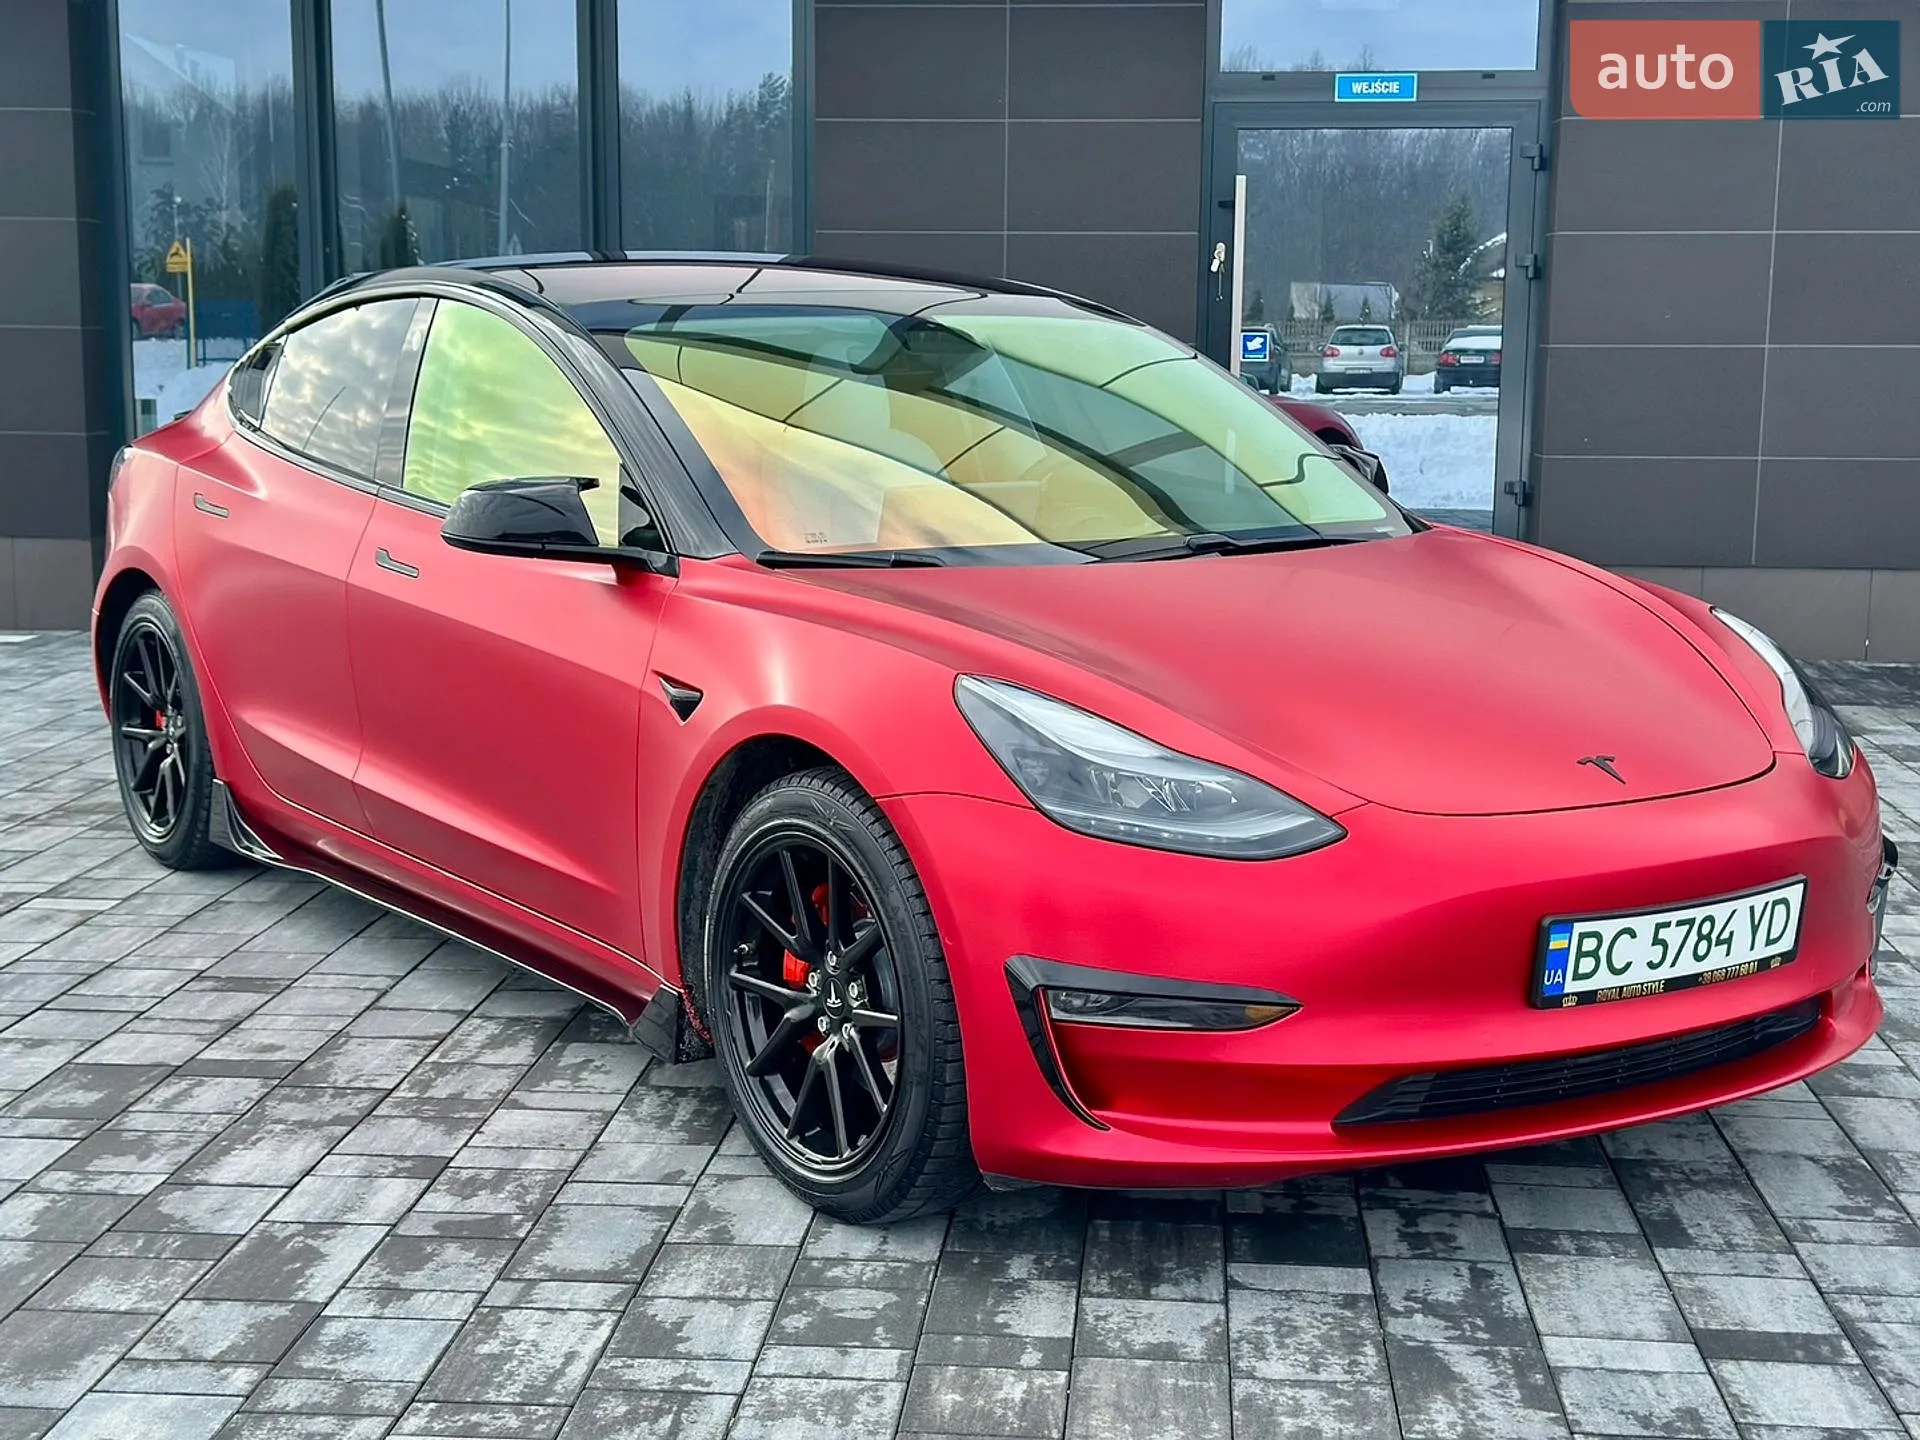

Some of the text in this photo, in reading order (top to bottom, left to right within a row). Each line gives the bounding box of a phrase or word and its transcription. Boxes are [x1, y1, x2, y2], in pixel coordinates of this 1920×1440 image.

[1351, 78, 1400, 94] WEJŚCIE
[1571, 897, 1791, 982] BC 5784 YD
[1544, 968, 1563, 985] UA
[1726, 965, 1739, 980] 777
[1596, 980, 1666, 1002] ROYAL AUTO STYLE
